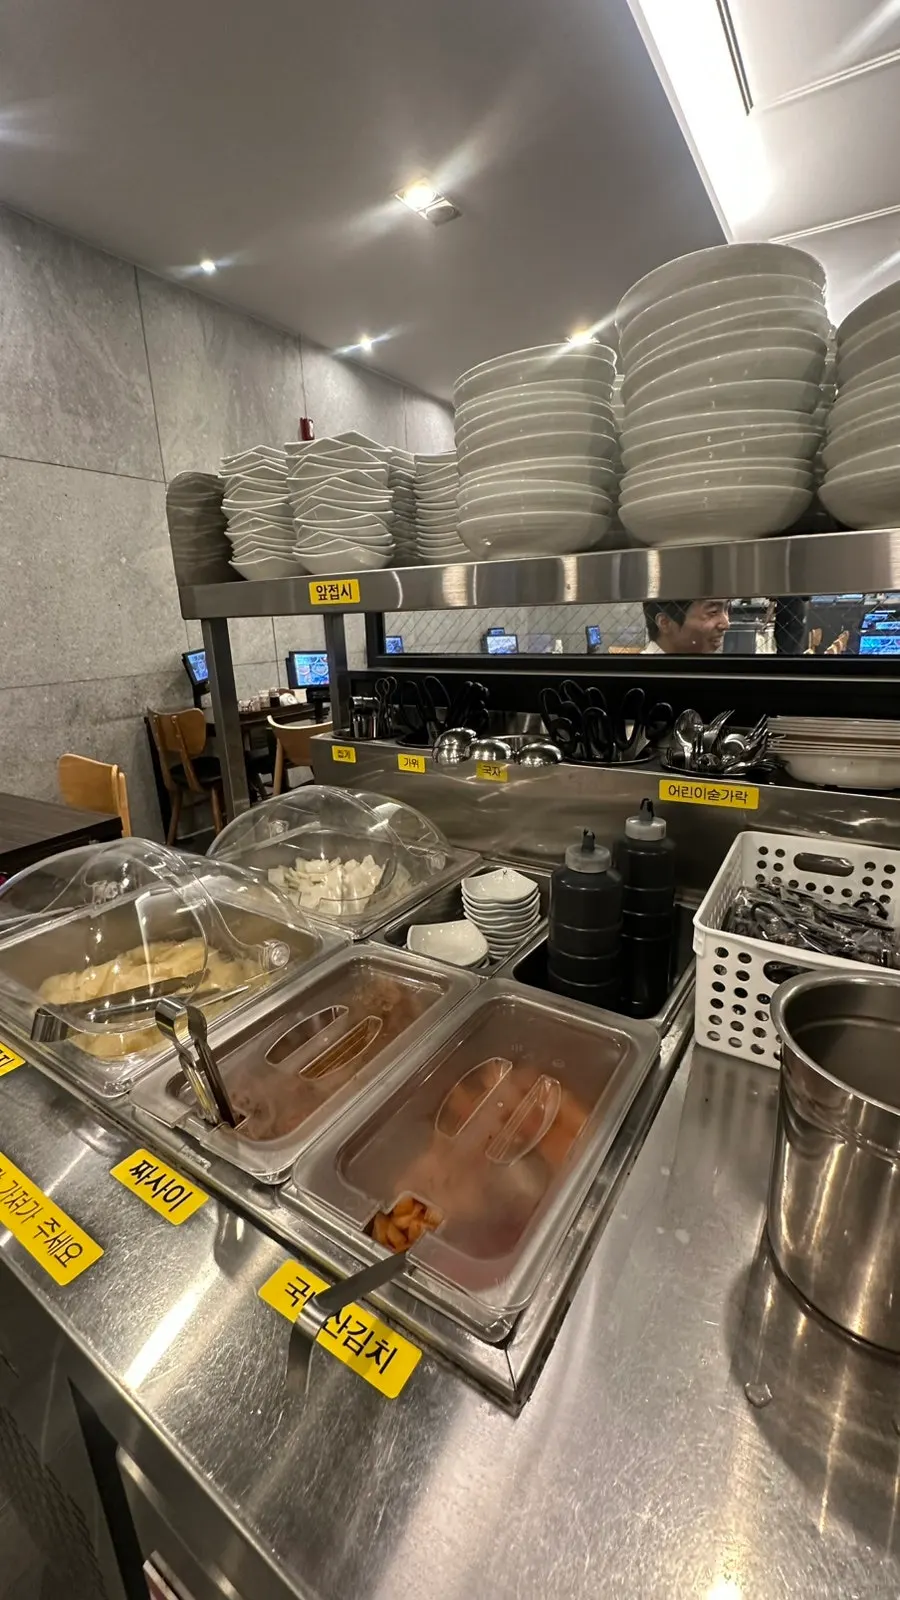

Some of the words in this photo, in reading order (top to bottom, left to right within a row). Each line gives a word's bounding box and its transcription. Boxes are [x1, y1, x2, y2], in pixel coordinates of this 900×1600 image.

[315, 583, 352, 601] 앞접시
[403, 757, 420, 769] 가위
[668, 784, 749, 804] 어린이숟가락
[129, 1159, 194, 1213] 짜사이
[0, 1179, 44, 1225] 가져가
[33, 1217, 84, 1269] 주세요
[284, 1275, 398, 1375] 국산김치
